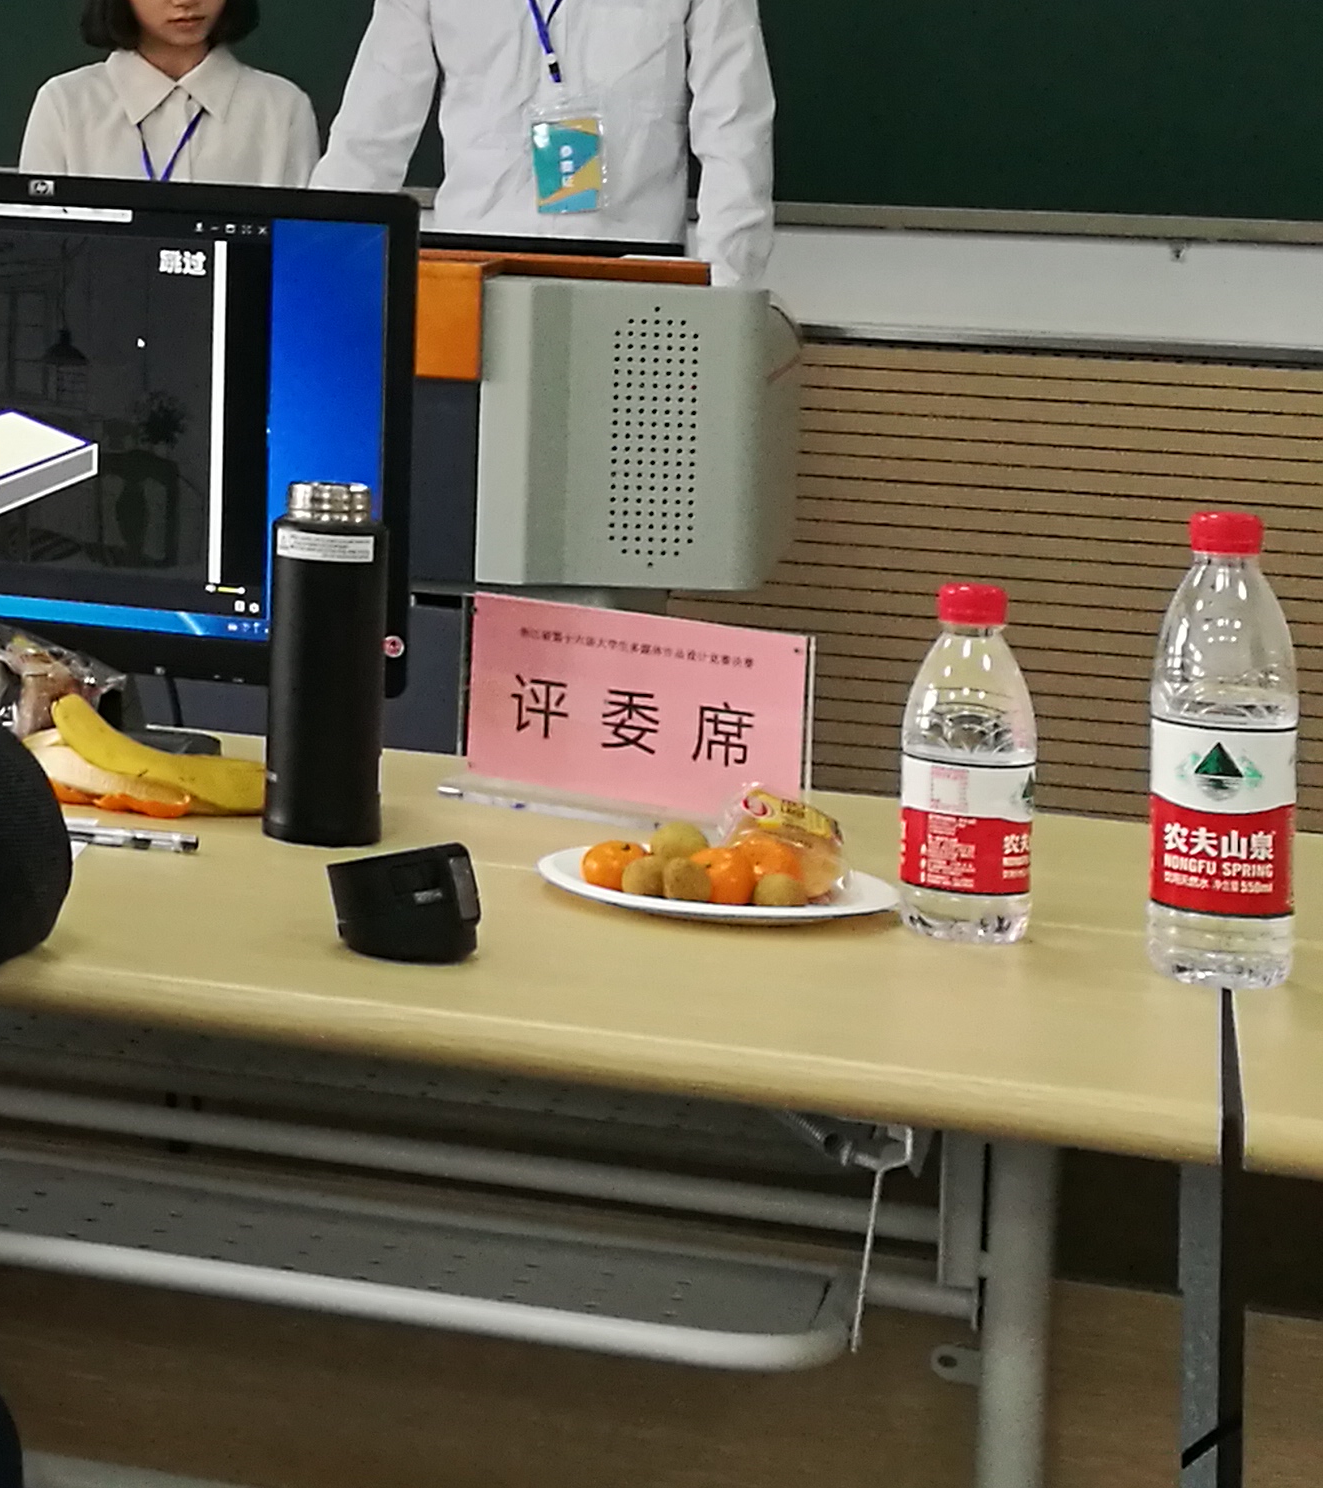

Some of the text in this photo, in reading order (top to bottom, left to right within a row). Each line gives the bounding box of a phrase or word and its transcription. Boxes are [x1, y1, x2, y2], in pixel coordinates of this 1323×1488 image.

[511, 674, 755, 768] 评委席
[1164, 822, 1274, 860] 农夫山泉
[1164, 853, 1274, 878] NONGFU SPRING
